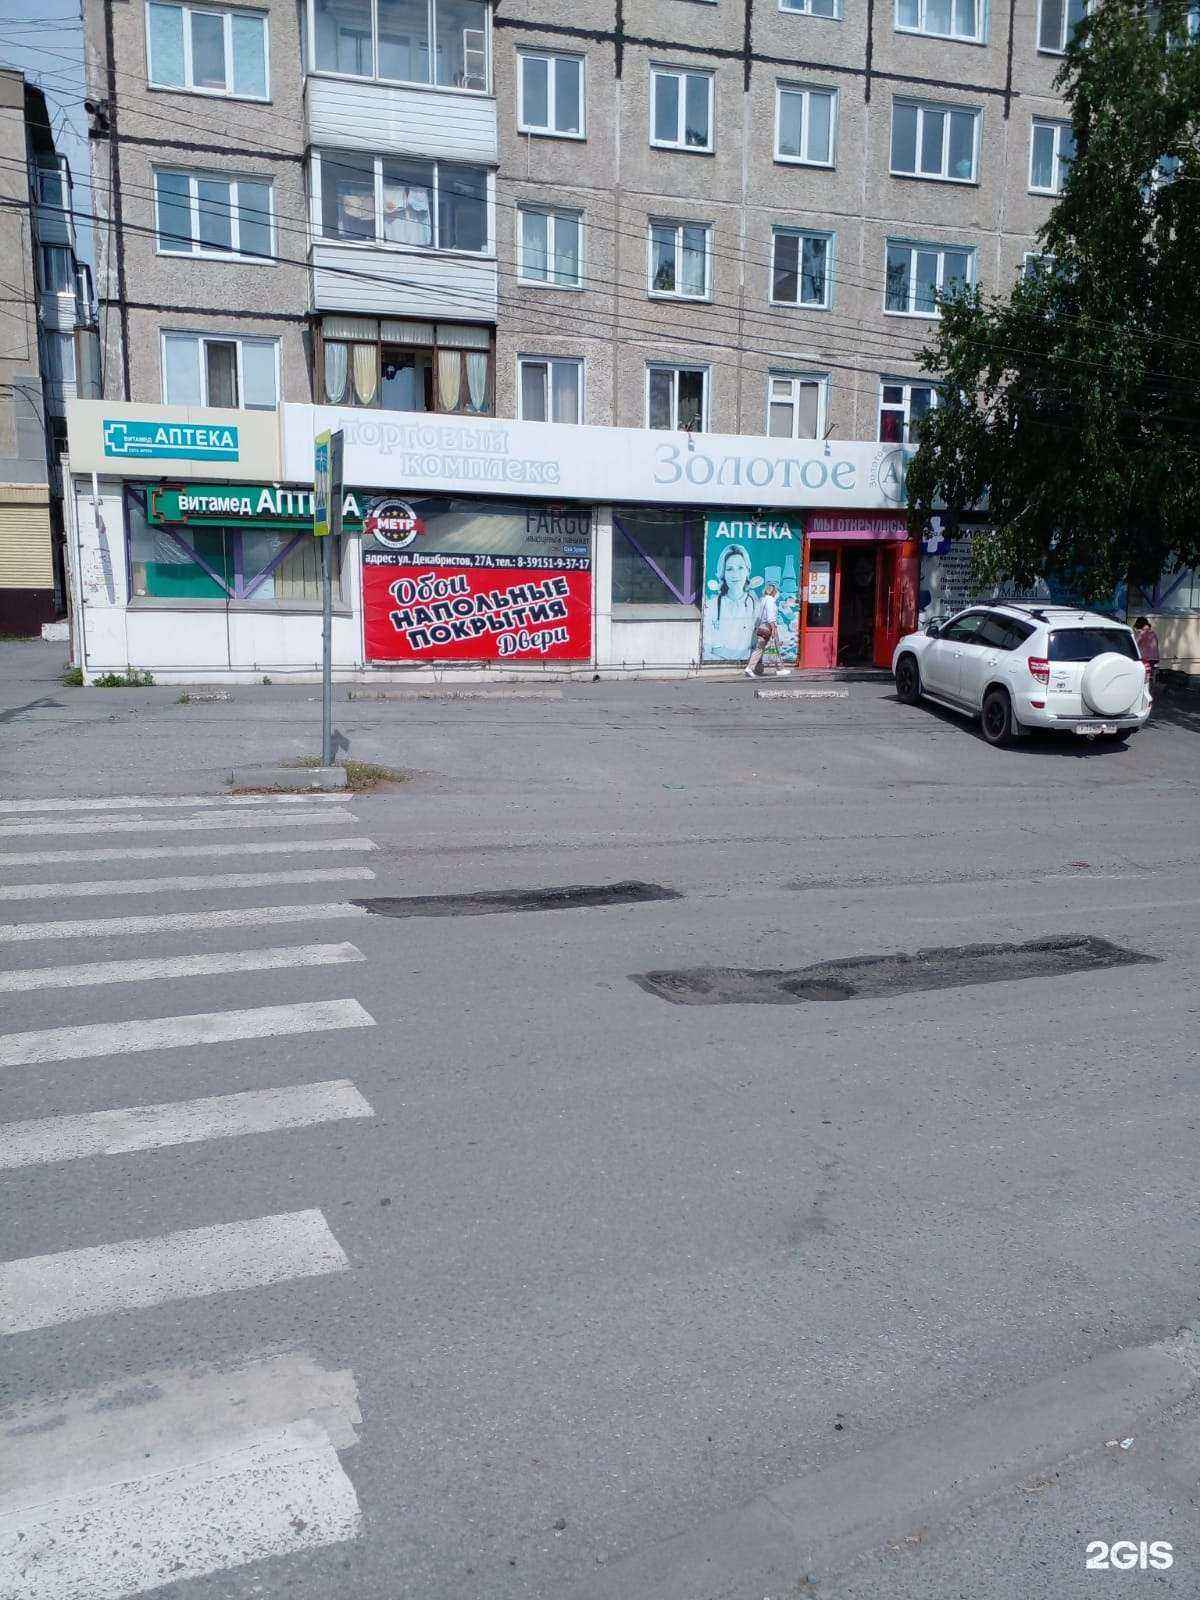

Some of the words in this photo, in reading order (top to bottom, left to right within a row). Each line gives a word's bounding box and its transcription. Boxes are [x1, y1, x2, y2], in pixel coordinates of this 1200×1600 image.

[155, 427, 234, 447] АПТЕКА
[653, 444, 857, 490] Золотое
[256, 489, 361, 517] АПТА
[377, 518, 415, 530] МЕТР
[715, 520, 792, 541] АПТЕКА
[813, 518, 835, 531] МЫ
[365, 553, 395, 566] адрес:
[397, 555, 411, 567] ул.
[412, 554, 473, 568] Декабристов,
[474, 555, 495, 568] 27А,
[517, 556, 590, 570] 8-39151-9-37-17
[390, 573, 470, 606] Обои
[390, 577, 570, 631] НАПОЛЬНЫЕ
[406, 599, 567, 650] ПОКРЫТИЯ
[497, 627, 569, 656] Двери
